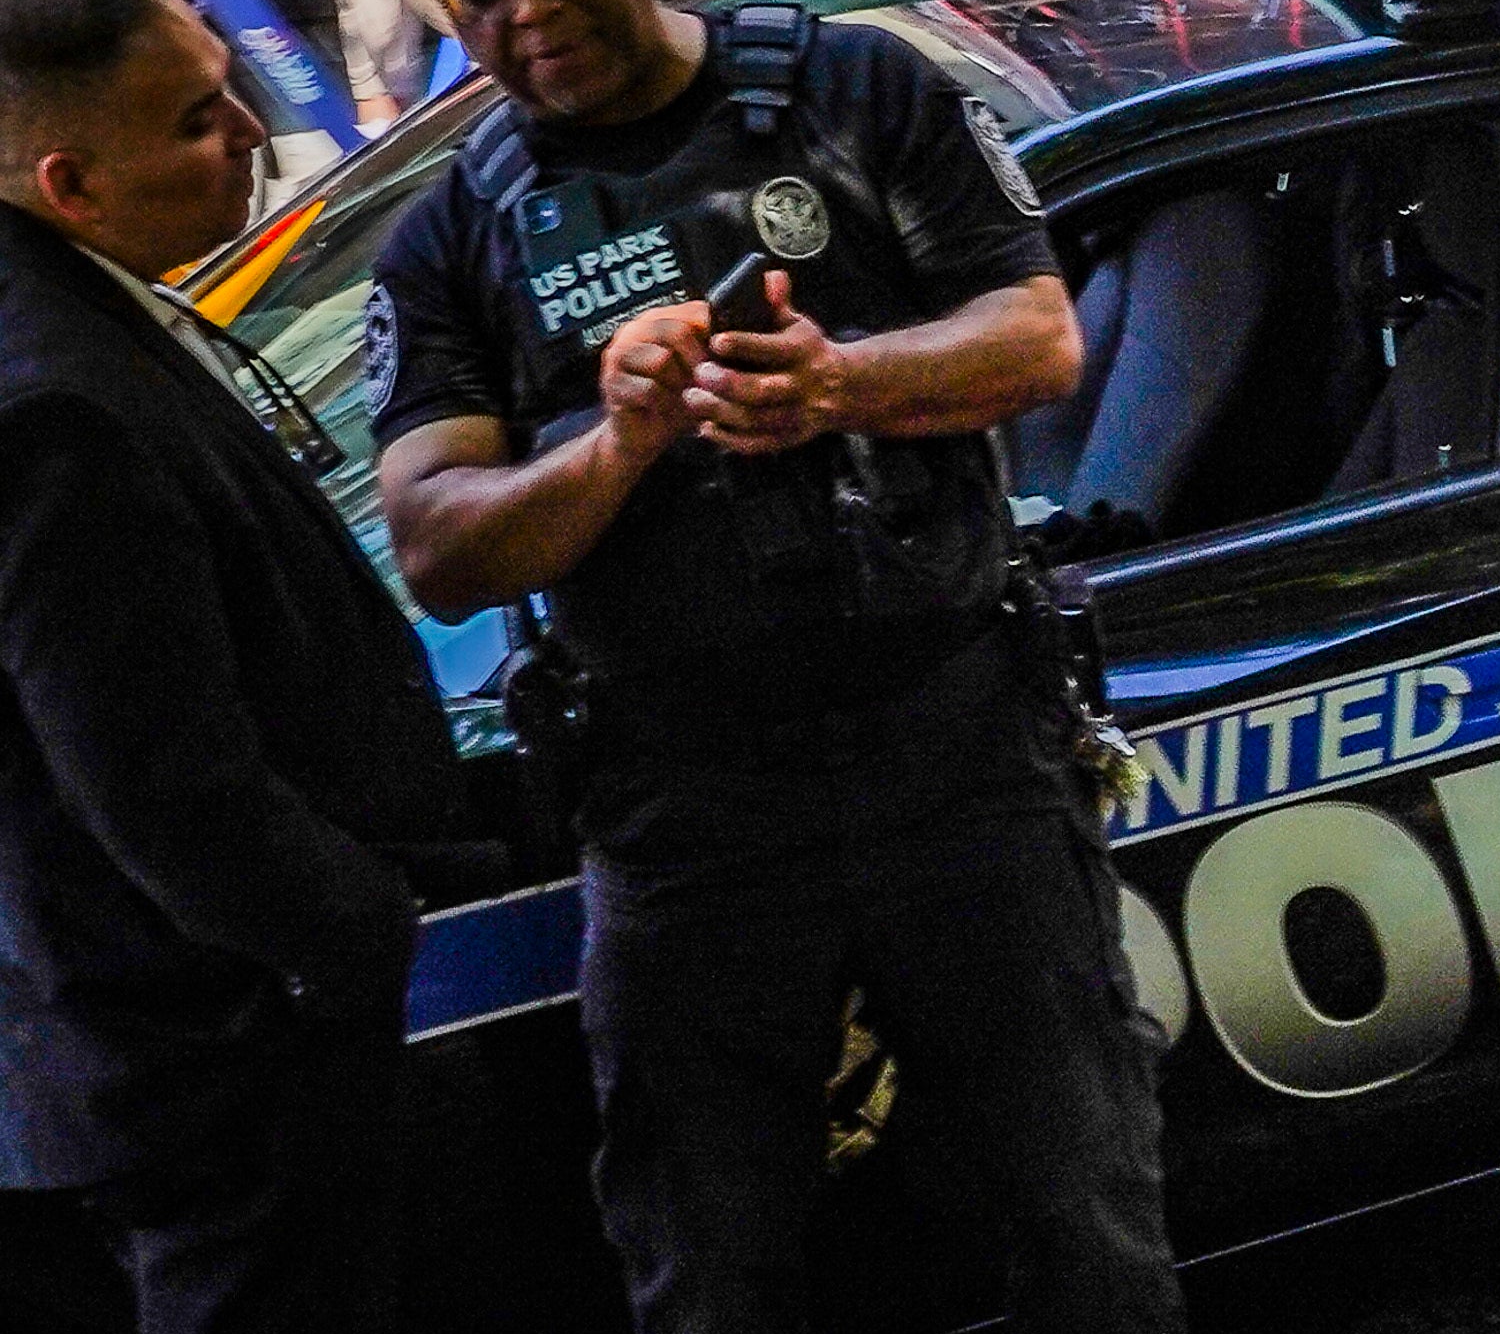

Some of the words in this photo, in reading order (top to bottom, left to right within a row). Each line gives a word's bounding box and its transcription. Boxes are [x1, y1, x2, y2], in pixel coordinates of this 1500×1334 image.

[529, 263, 577, 297] US
[575, 224, 670, 277] PARK
[539, 250, 683, 332] POLICE
[1104, 667, 1464, 830] NITED
